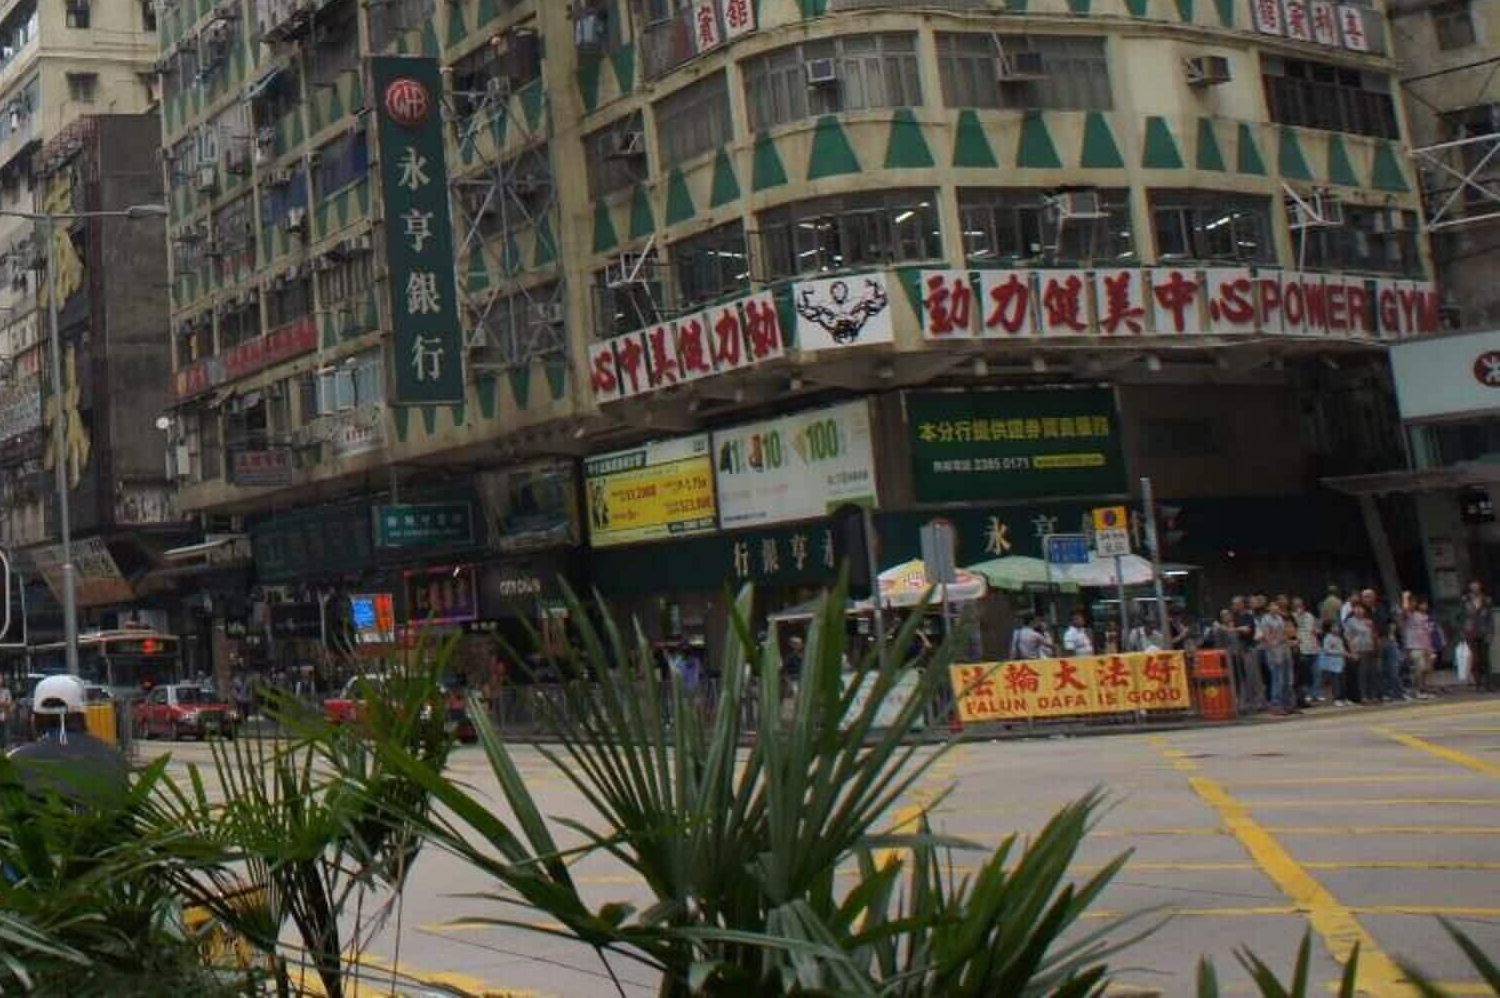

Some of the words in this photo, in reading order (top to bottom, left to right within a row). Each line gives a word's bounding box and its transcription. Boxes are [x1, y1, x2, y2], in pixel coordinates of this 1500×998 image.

[397, 146, 444, 382] 永亨銀行
[924, 271, 1255, 335] 動力健美中心
[1259, 278, 1368, 332] POWER
[1379, 288, 1444, 334] GYM
[960, 652, 1180, 698] 法輪大法好
[1037, 693, 1087, 710] DAFA
[1098, 693, 1119, 707] IS
[1127, 688, 1182, 704] GOOD
